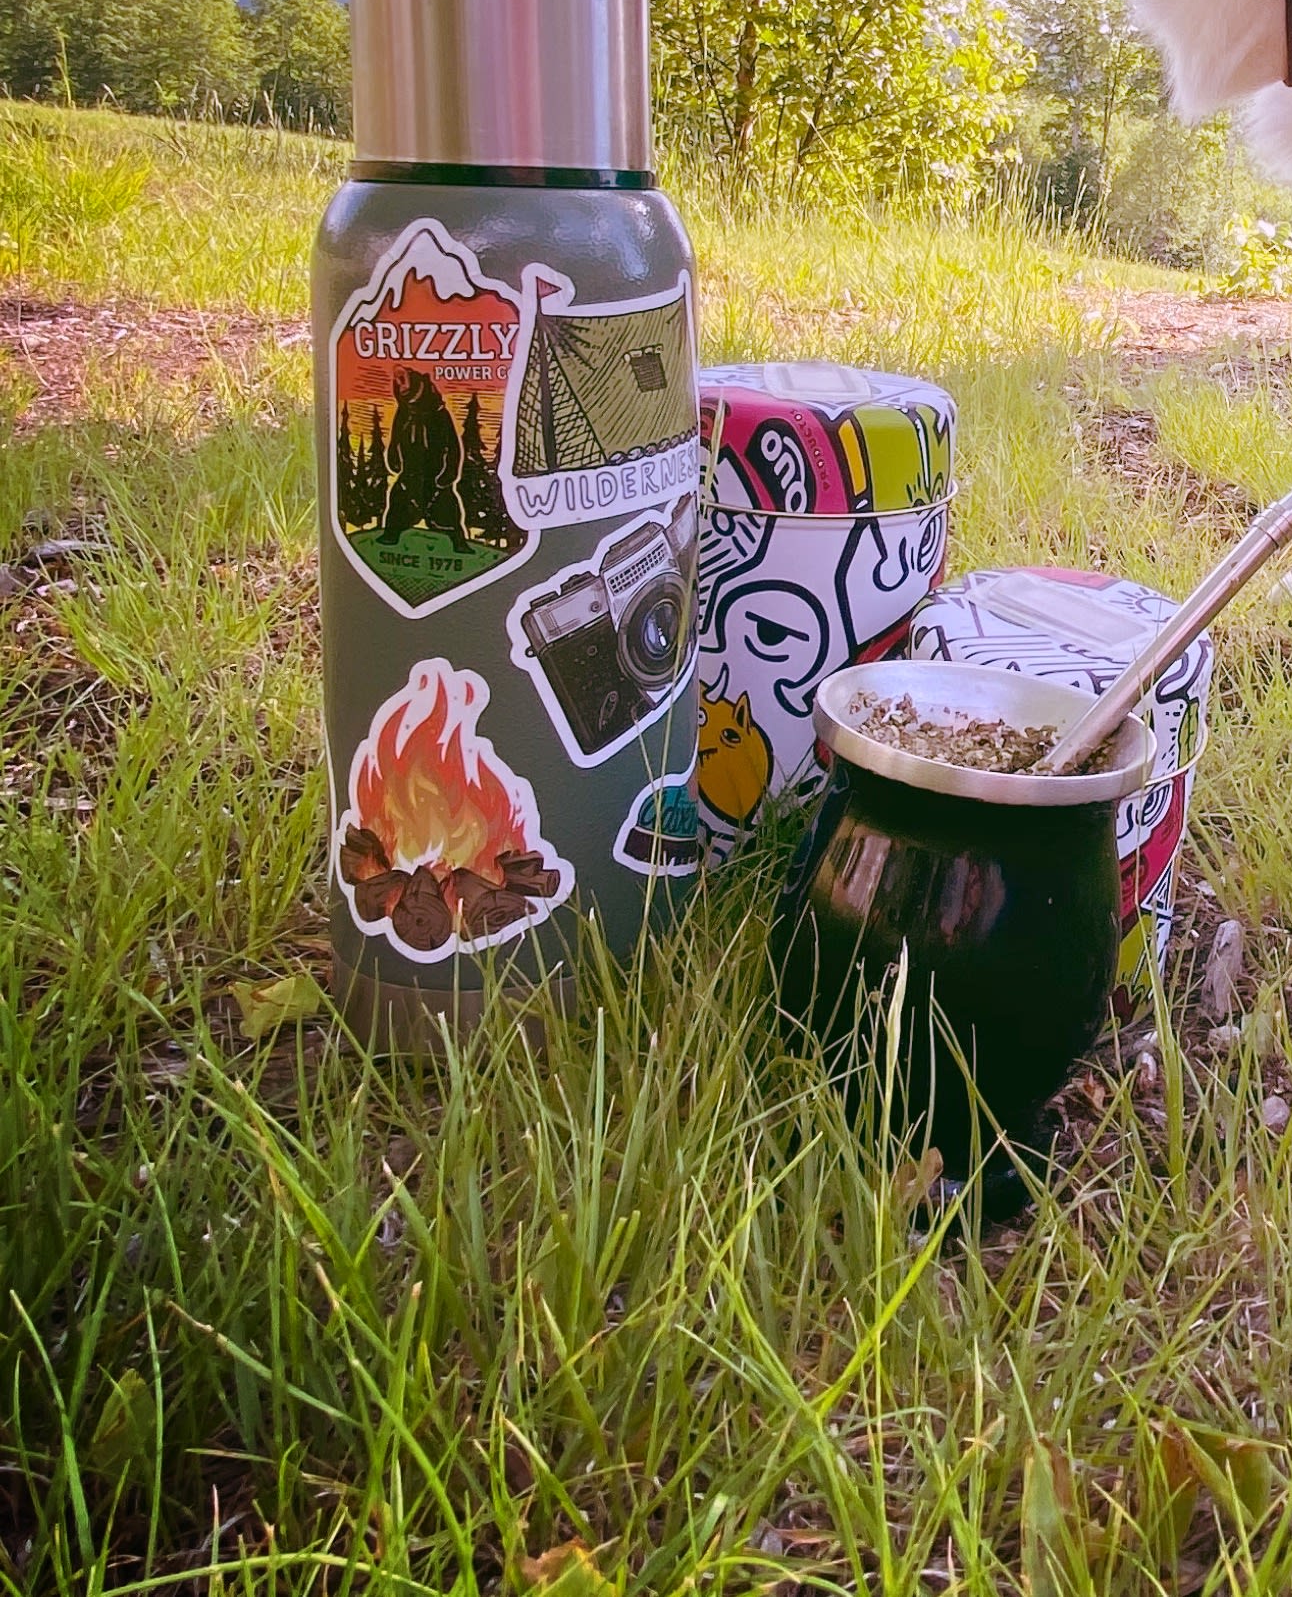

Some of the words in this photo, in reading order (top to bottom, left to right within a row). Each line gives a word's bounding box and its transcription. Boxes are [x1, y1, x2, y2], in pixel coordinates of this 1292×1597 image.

[354, 321, 519, 361] GRIZZLY
[435, 365, 493, 381] POWER
[496, 366, 512, 380] C
[516, 439, 698, 517] WILDERNES
[379, 551, 420, 568] SINCE
